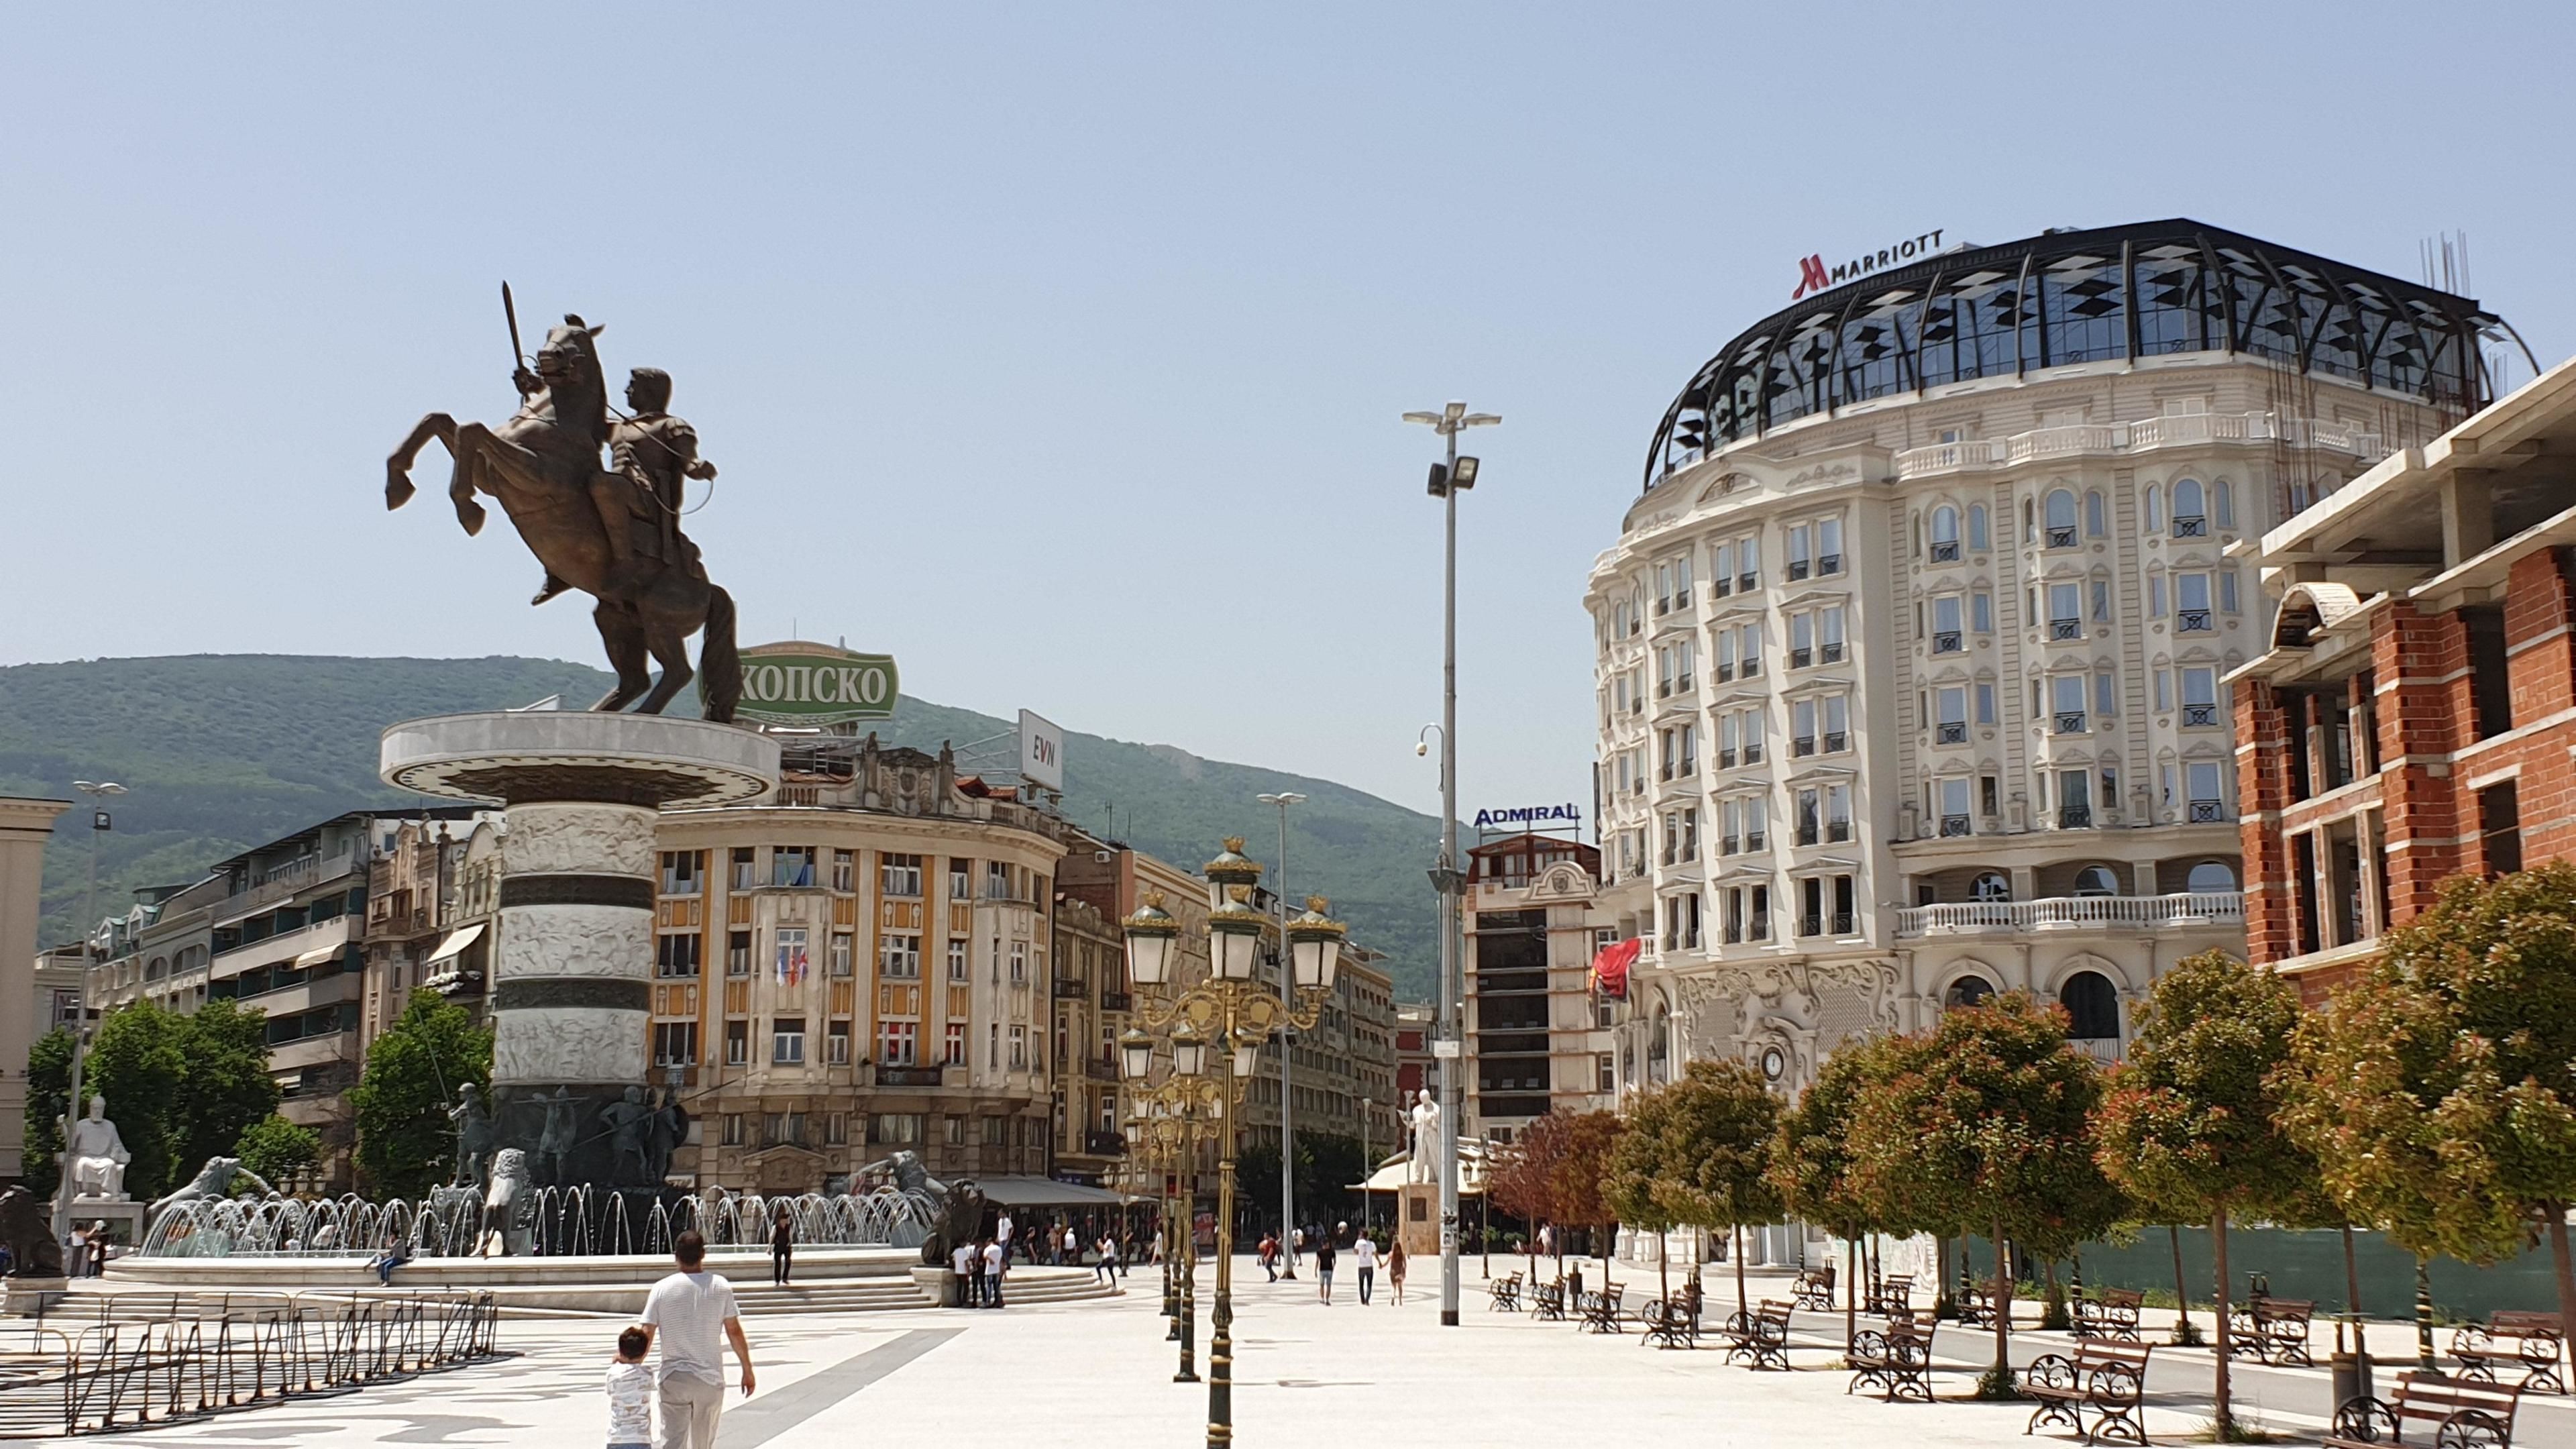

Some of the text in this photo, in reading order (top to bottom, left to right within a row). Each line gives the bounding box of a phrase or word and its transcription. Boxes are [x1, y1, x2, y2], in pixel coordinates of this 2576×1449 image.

[1831, 229, 1943, 284] MARRIOTT
[740, 665, 887, 704] КОПСКО
[1033, 734, 1055, 767] EVN
[1474, 803, 1580, 826] ADMIRAL
